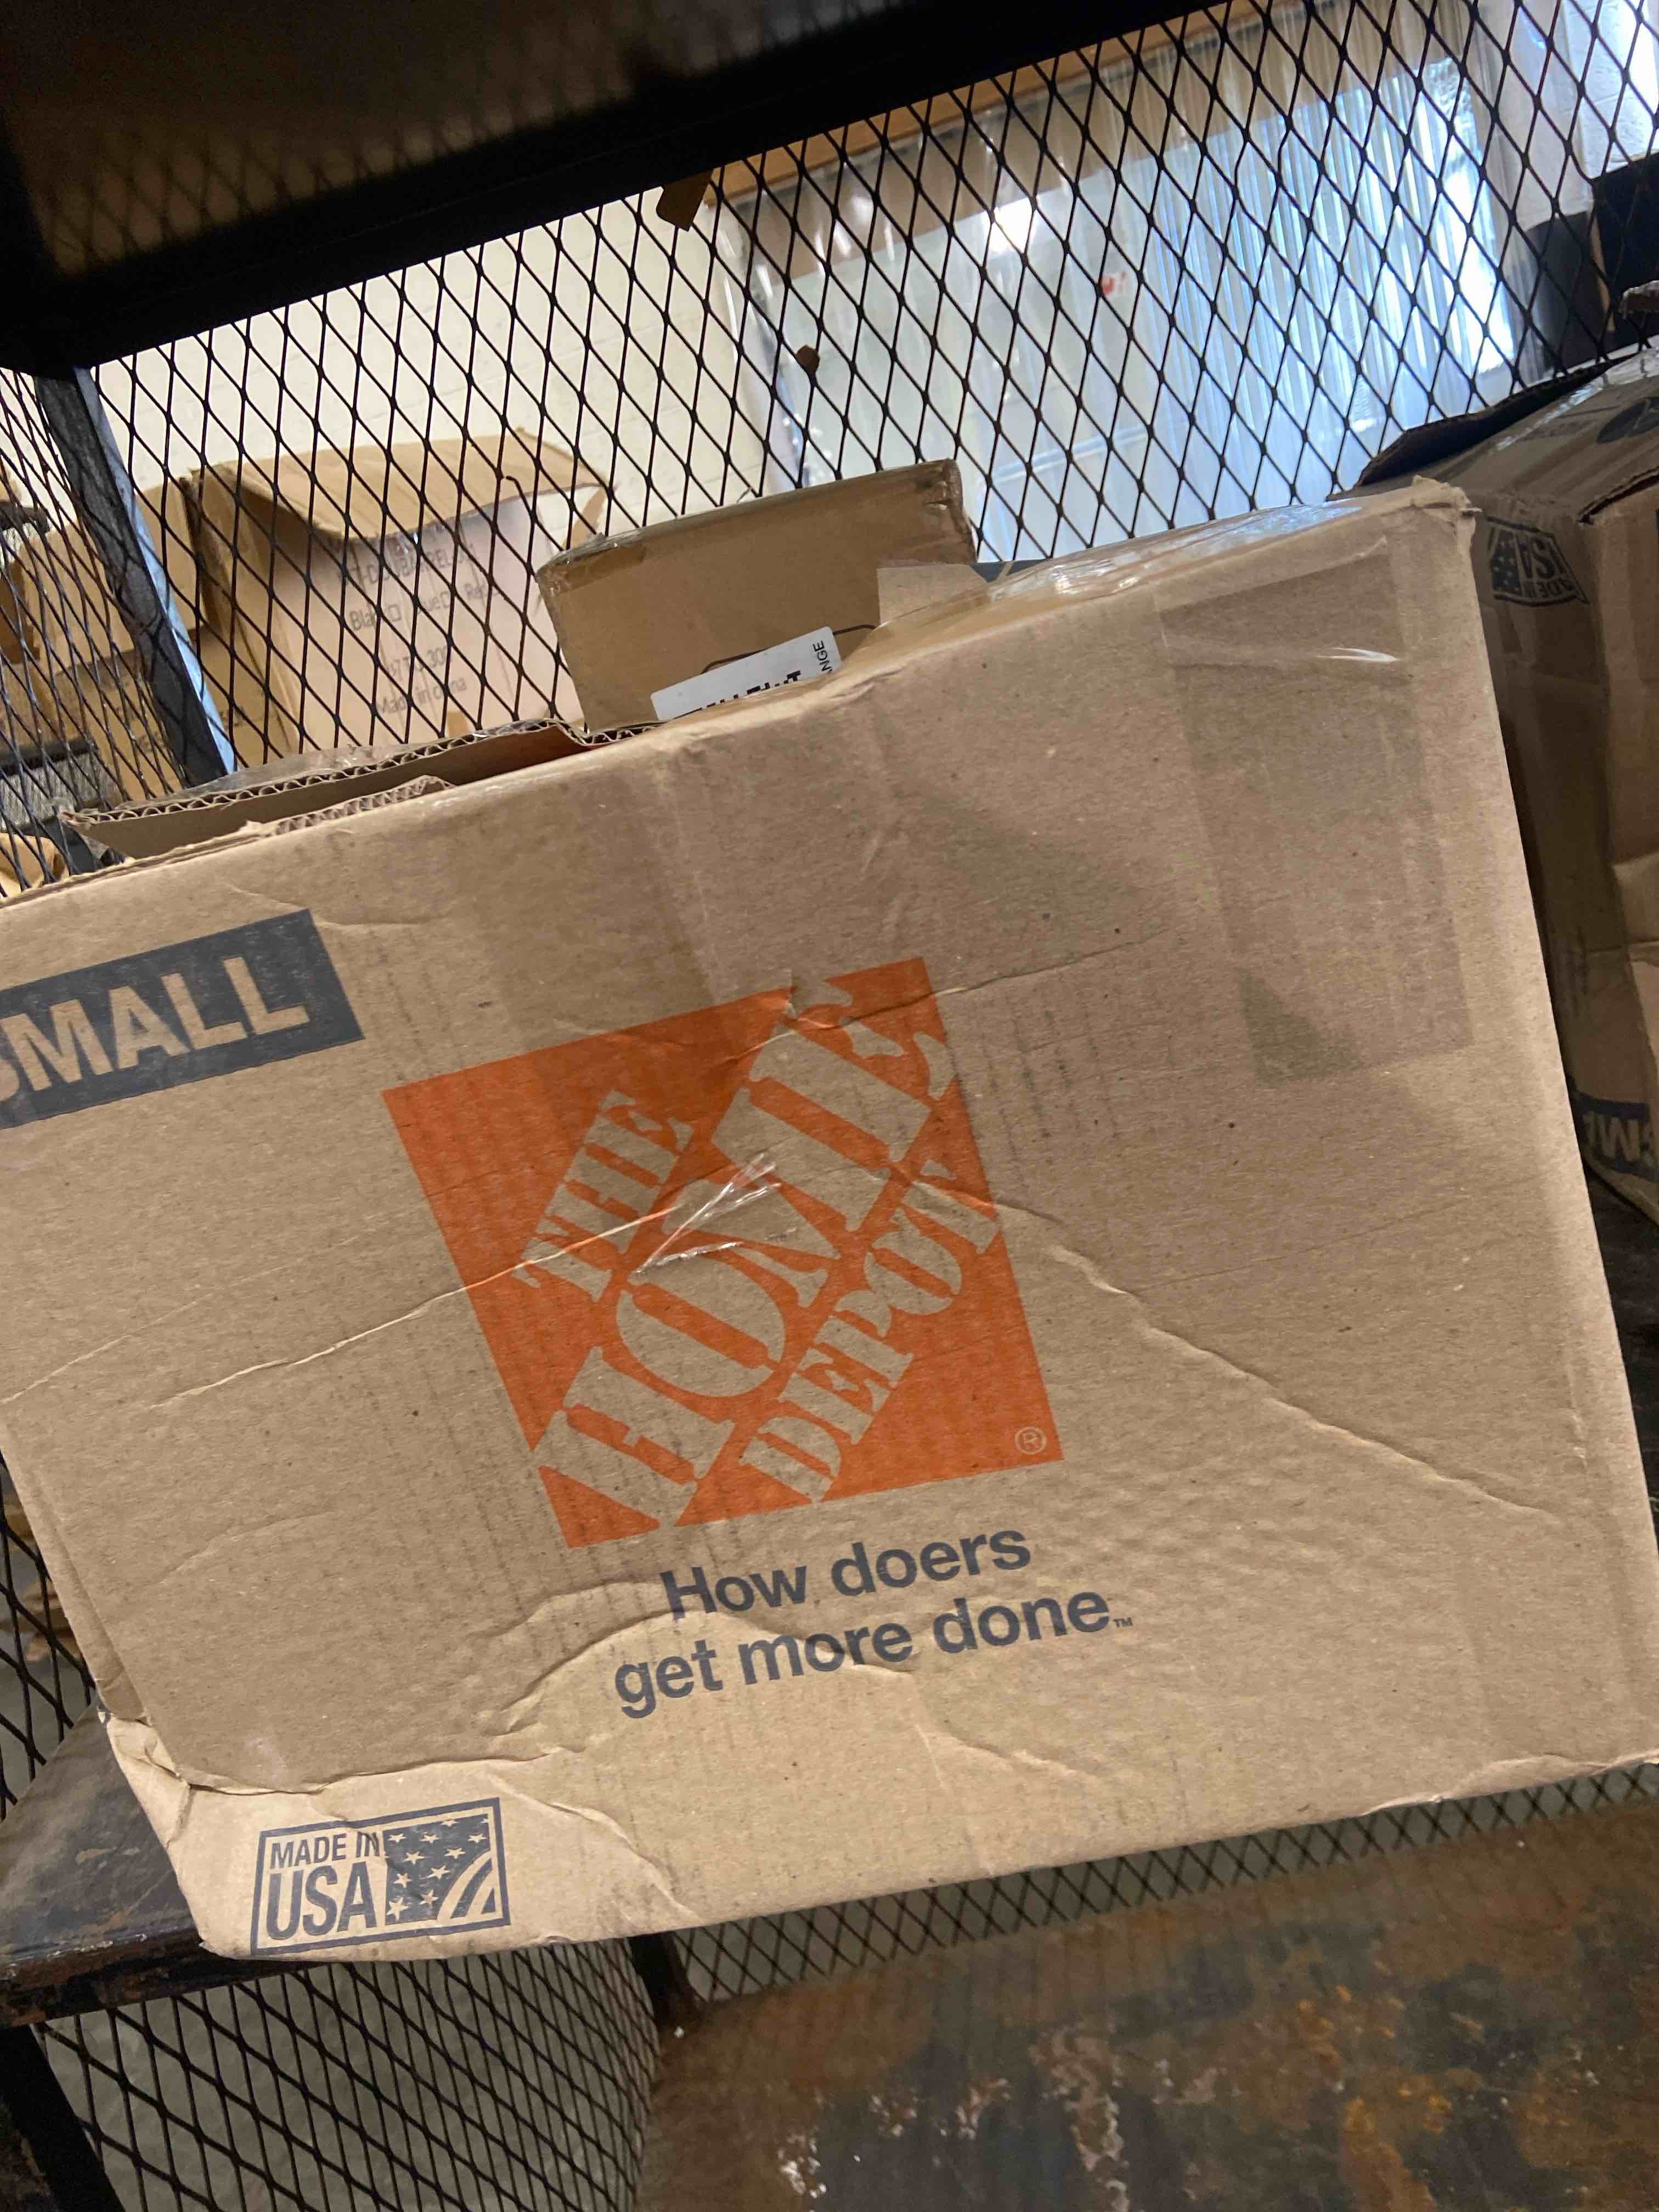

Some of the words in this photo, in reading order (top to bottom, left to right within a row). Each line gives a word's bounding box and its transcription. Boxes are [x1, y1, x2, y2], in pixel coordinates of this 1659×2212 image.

[812, 640, 833, 673] NGE
[0, 956, 311, 1101] MALL
[511, 1089, 692, 1303] THE
[534, 974, 960, 1531] HOME
[738, 1156, 1003, 1505] DEPOT
[660, 1565, 808, 1620] How
[831, 1529, 1032, 1596] doers
[614, 1640, 724, 1719] get
[738, 1621, 914, 1686] more
[270, 1832, 347, 1869] MADE
[356, 1831, 380, 1859] IN
[266, 1861, 377, 1941] USA
